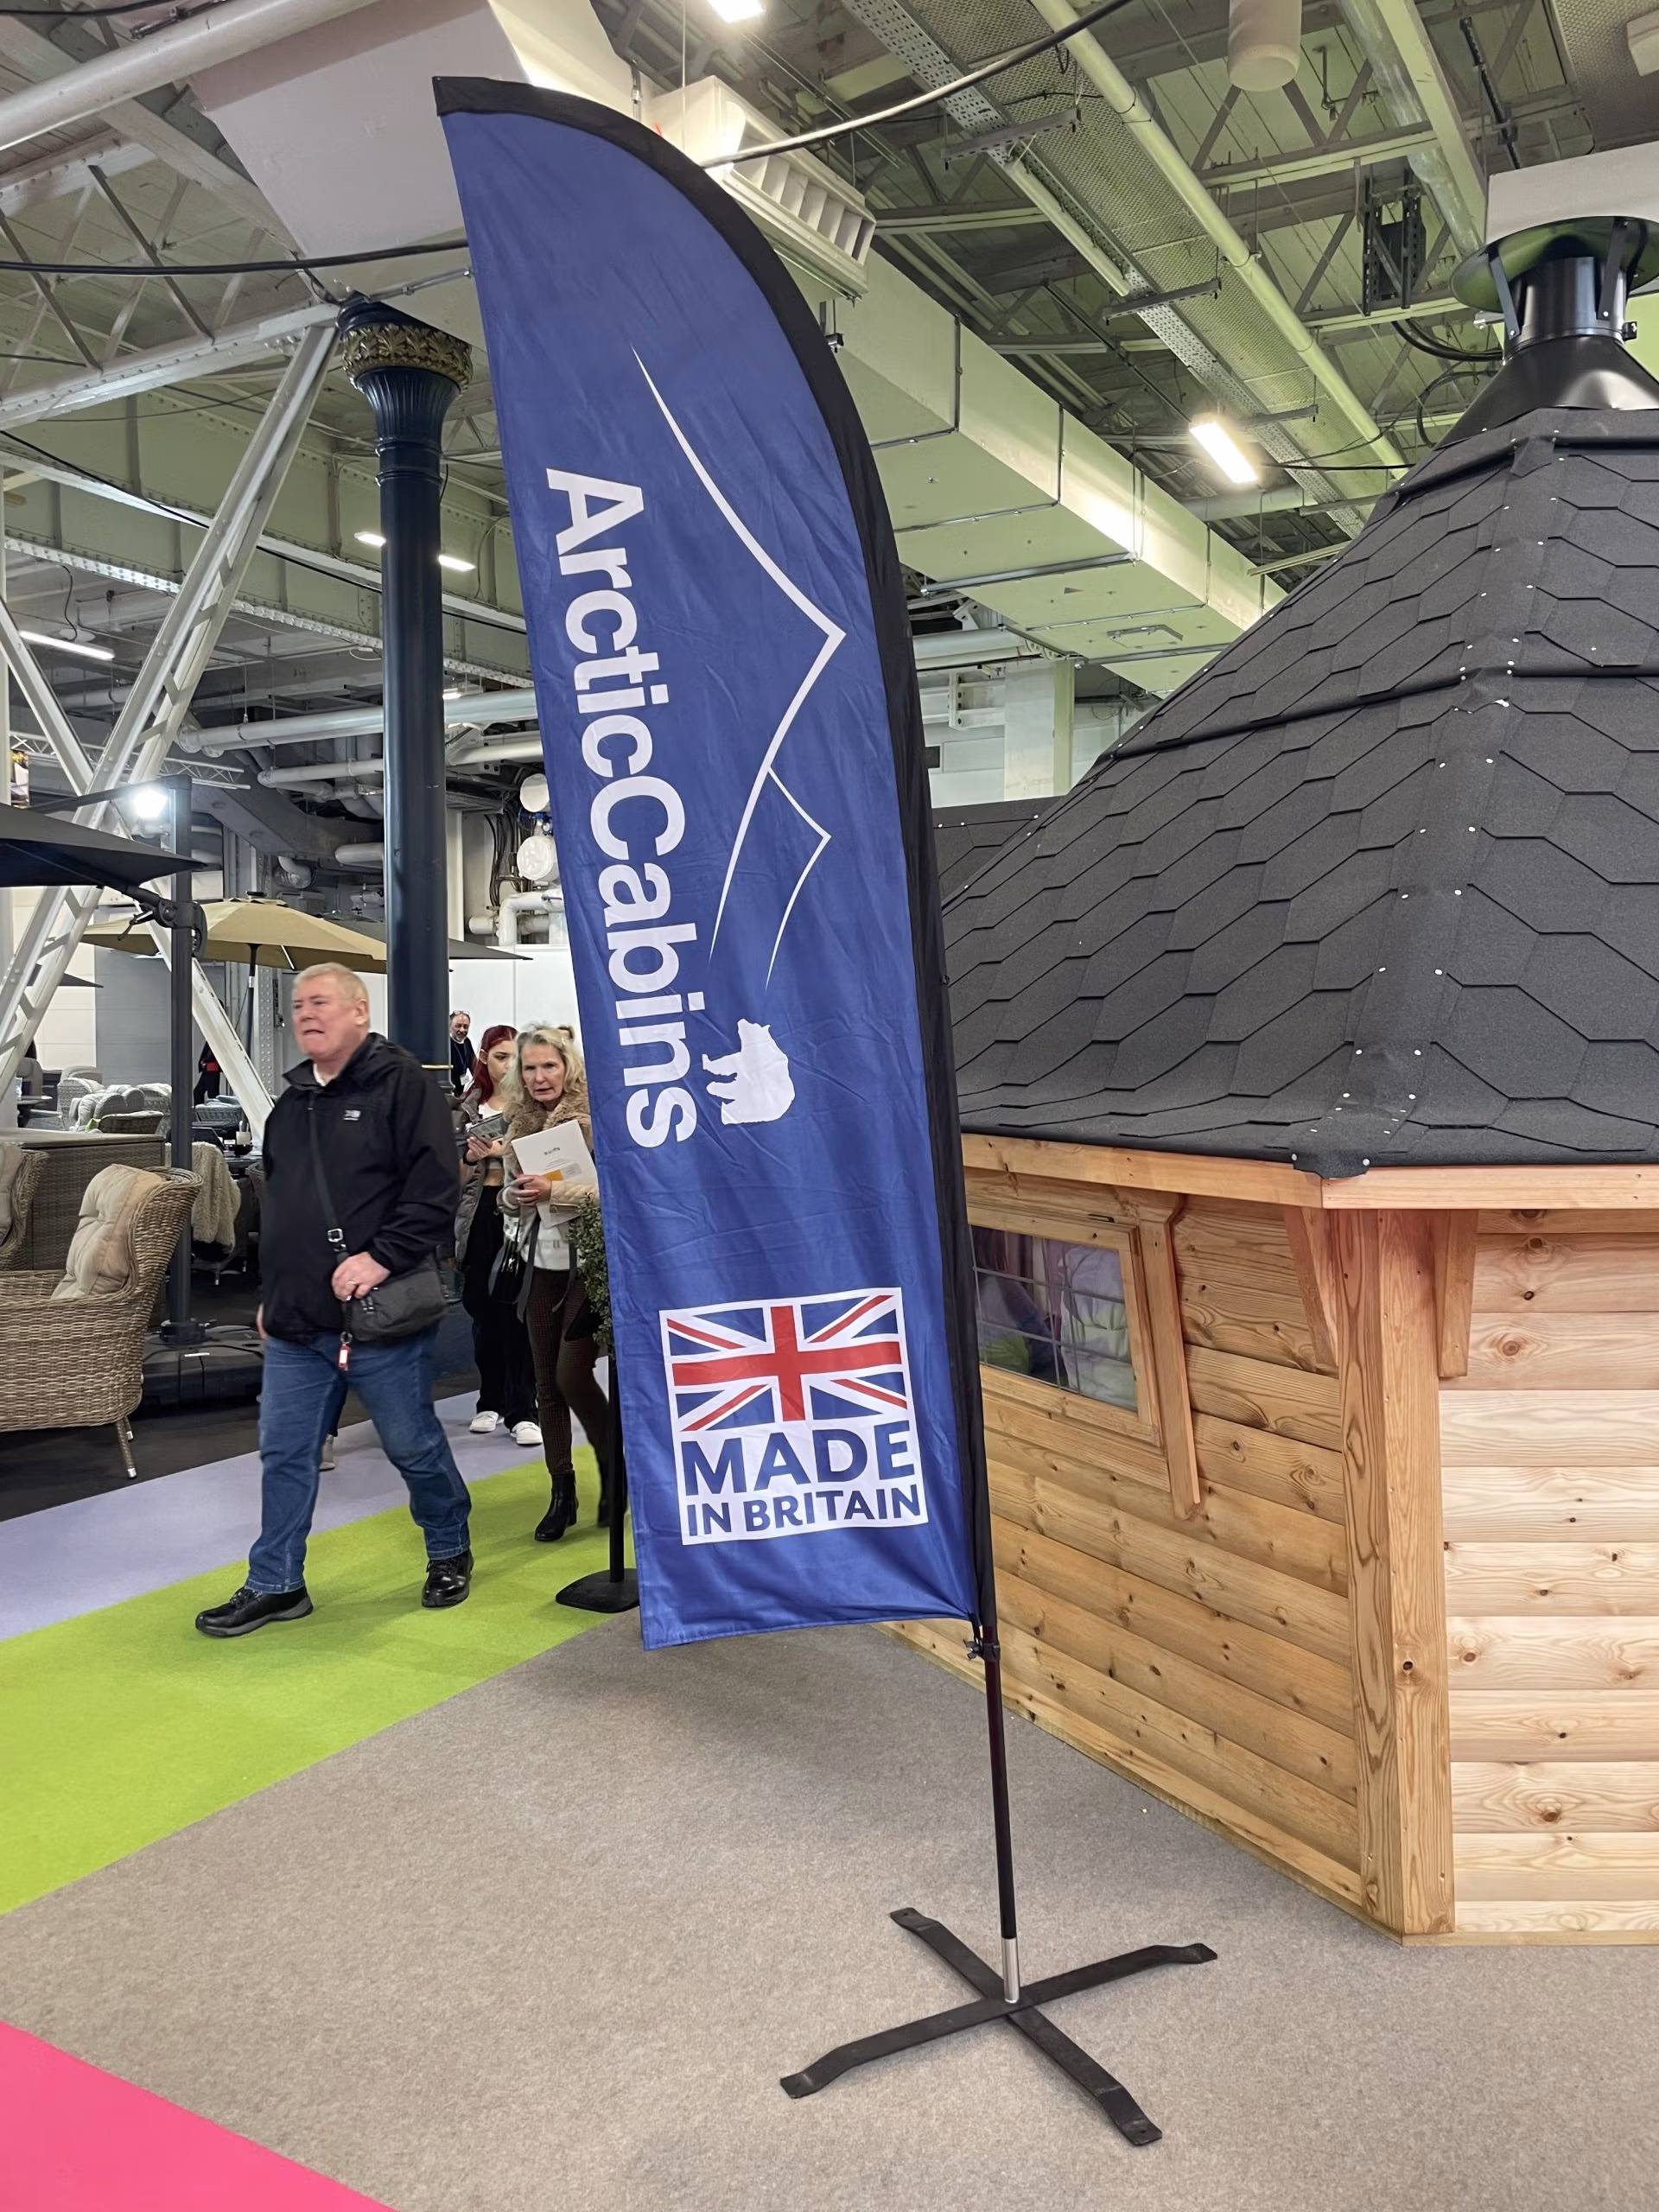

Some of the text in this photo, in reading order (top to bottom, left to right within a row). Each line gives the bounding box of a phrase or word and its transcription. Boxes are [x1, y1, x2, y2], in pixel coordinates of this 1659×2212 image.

[546, 468, 705, 1147] ArcticCabins
[682, 1421, 914, 1496] MADE
[688, 1484, 921, 1536] IN BRITAIN
